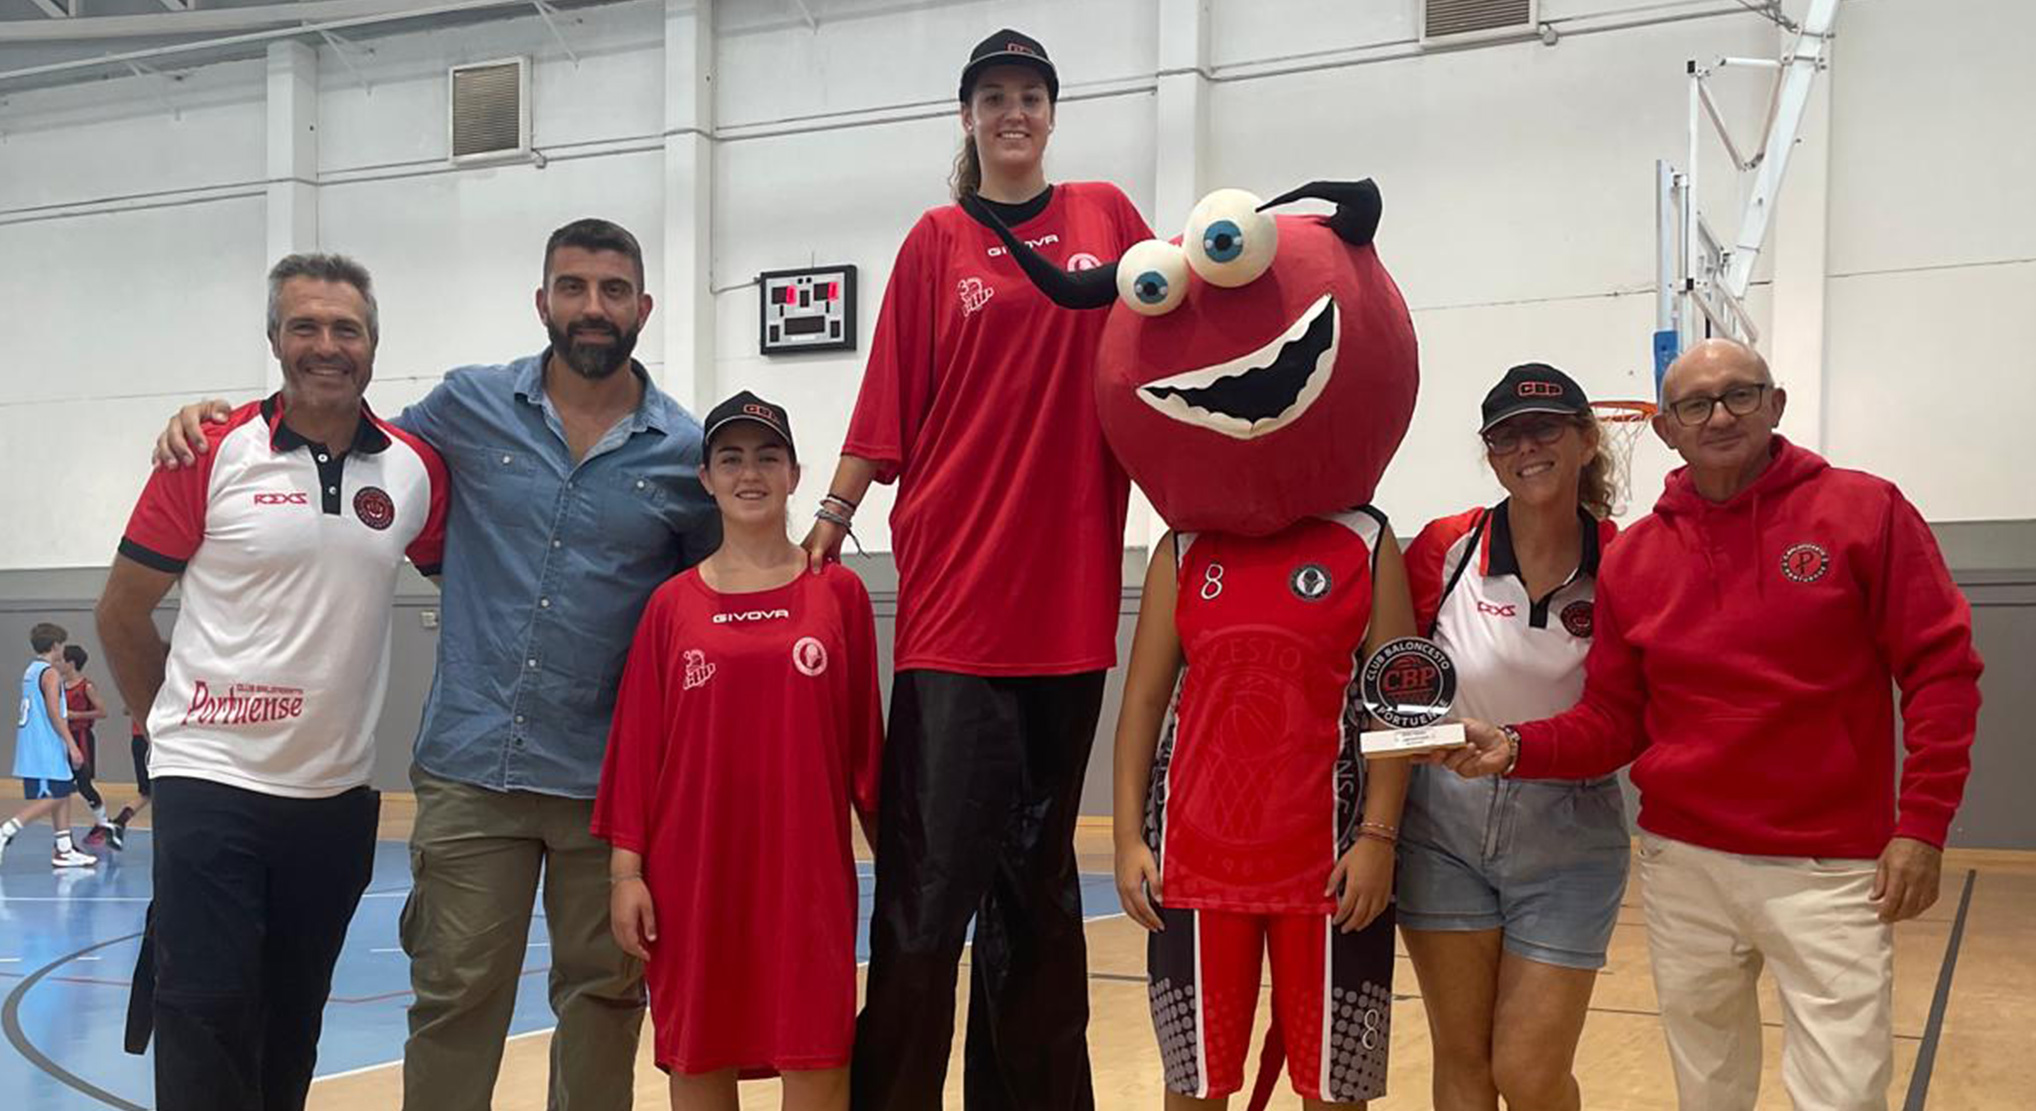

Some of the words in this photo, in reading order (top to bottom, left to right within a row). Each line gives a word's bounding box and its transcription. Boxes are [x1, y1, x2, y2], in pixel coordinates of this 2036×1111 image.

[1201, 564, 1223, 599] 8
[712, 608, 789, 624] GIVOVA
[1366, 655, 1385, 681] CLUB
[1383, 641, 1450, 671] BALONCESTO
[1384, 667, 1436, 691] CBP
[181, 680, 303, 725] Portuense
[1362, 1008, 1380, 1051] 8
